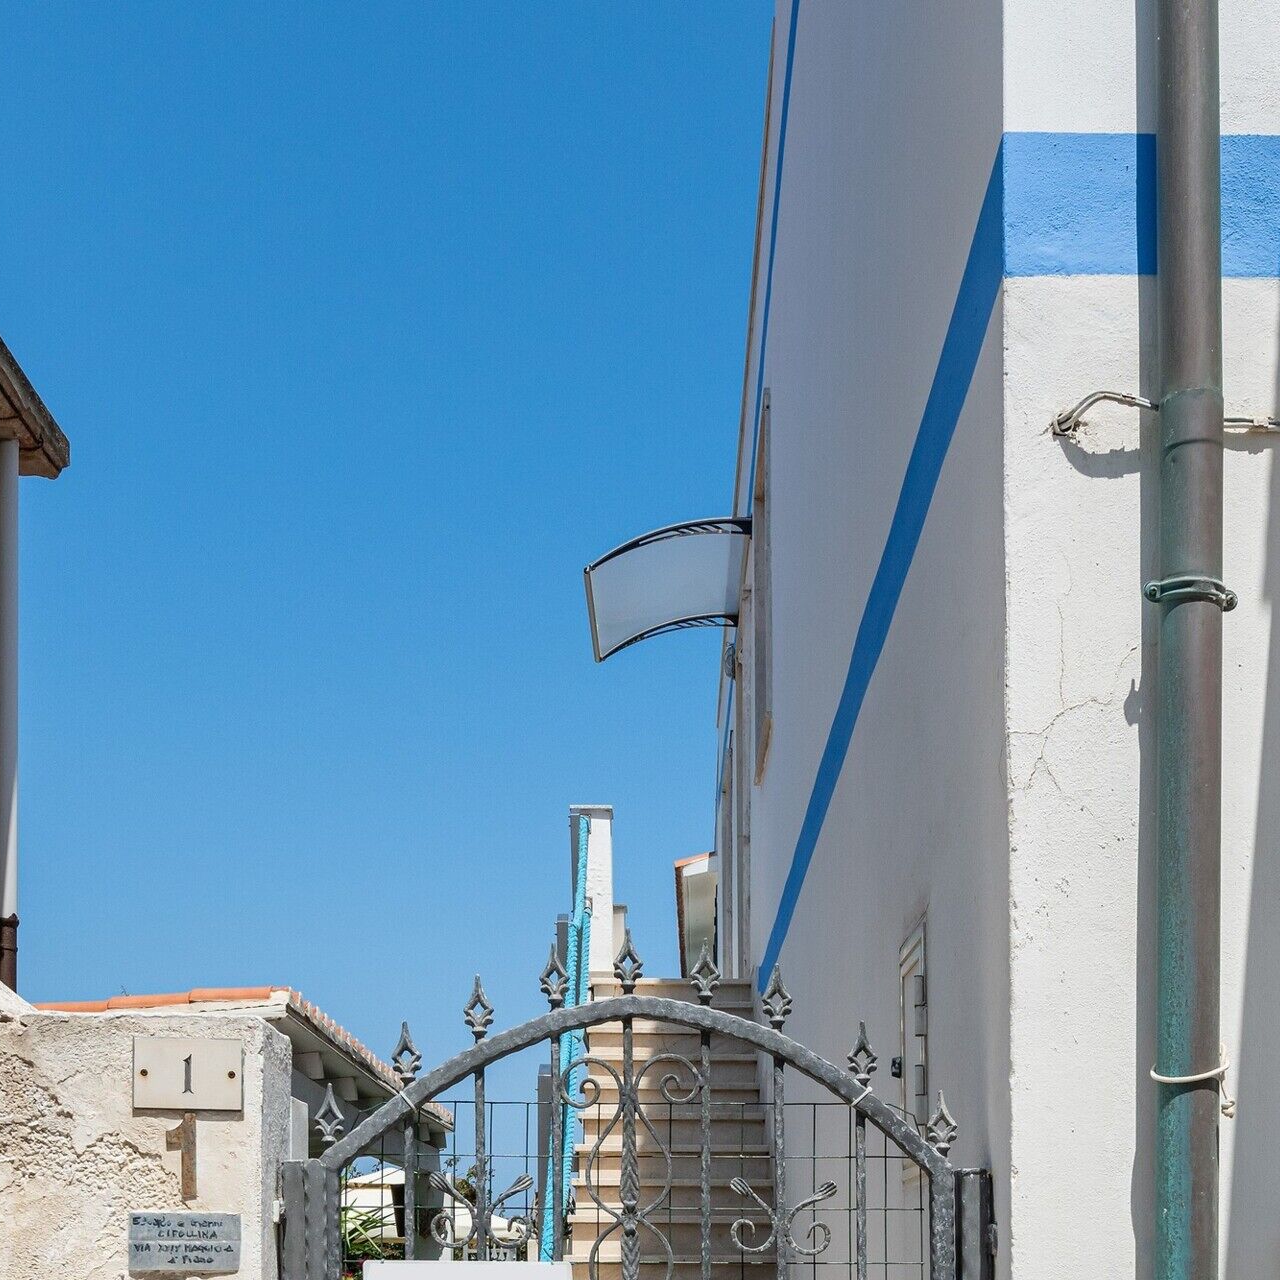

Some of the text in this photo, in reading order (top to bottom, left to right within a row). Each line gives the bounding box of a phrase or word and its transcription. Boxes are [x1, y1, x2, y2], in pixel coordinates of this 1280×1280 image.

[181, 1053, 195, 1095] 1
[165, 1112, 198, 1200] 1
[133, 1243, 151, 1253] VIA
